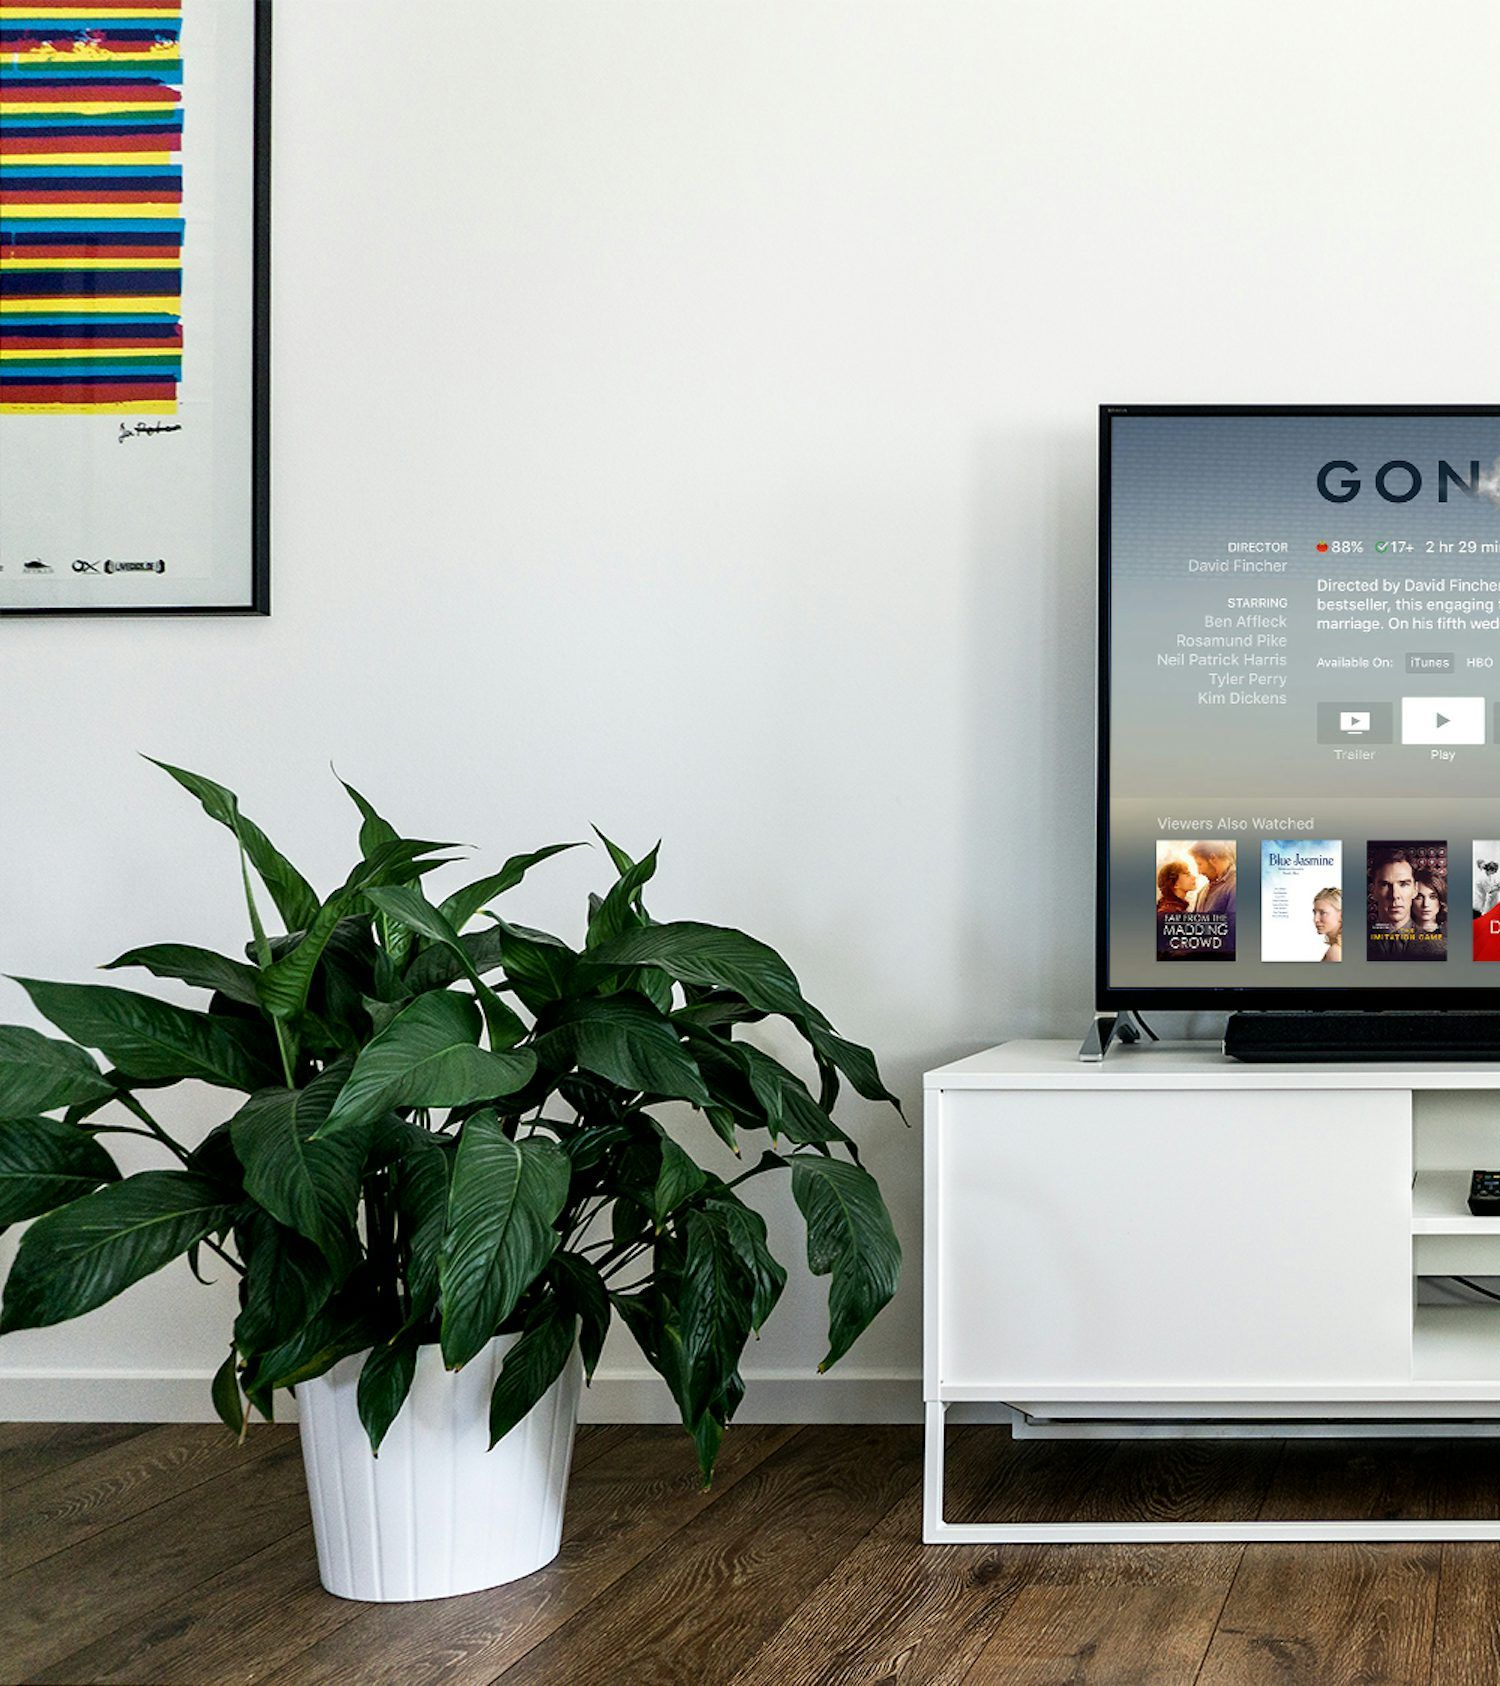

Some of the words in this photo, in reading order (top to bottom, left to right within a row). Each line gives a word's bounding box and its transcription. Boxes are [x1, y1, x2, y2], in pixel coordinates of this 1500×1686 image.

[1227, 542, 1288, 553] DIRECTOR
[1331, 541, 1364, 553] 88%
[1390, 541, 1415, 553] 17+
[1425, 541, 1435, 553] 2
[1439, 541, 1454, 553] hr
[1458, 541, 1477, 553] 29
[1188, 559, 1229, 573] David
[1233, 559, 1288, 573] Fincher
[1316, 579, 1378, 592] Directed
[1382, 579, 1400, 595] by
[1404, 579, 1445, 592] David
[1227, 598, 1288, 608] STARRING
[1316, 598, 1391, 613] bestseller,
[1395, 598, 1423, 611] this
[1427, 599, 1494, 614] engaging
[1204, 615, 1232, 628] Ben
[1236, 615, 1288, 628] Affleck
[1316, 617, 1384, 633] marriage.
[1388, 617, 1409, 630] On
[1412, 617, 1434, 630] his
[1437, 617, 1466, 630] fifth
[1176, 634, 1253, 647] Rosamund
[1257, 634, 1288, 647] Pike
[1157, 653, 1185, 666] Neil
[1189, 653, 1239, 666] Patrick
[1244, 653, 1287, 666] Harris
[1316, 657, 1369, 669] Available
[1372, 657, 1393, 669] On:
[1410, 657, 1450, 669] iTunes
[1466, 657, 1494, 668] HBO
[1209, 672, 1245, 688] Tyler
[1248, 672, 1288, 688] Perry
[1198, 691, 1225, 704] Kim
[1229, 691, 1288, 705] Dickens
[1333, 750, 1376, 761] Trailer
[1430, 750, 1456, 762] Play
[1157, 817, 1213, 831] Viewers
[1217, 817, 1248, 831] Also
[1252, 817, 1315, 831] Watched
[1269, 853, 1292, 866] Blue
[1293, 853, 1334, 866] Jasmine
[1163, 924, 1229, 936] MADDING
[1169, 937, 1222, 949] CROWD
